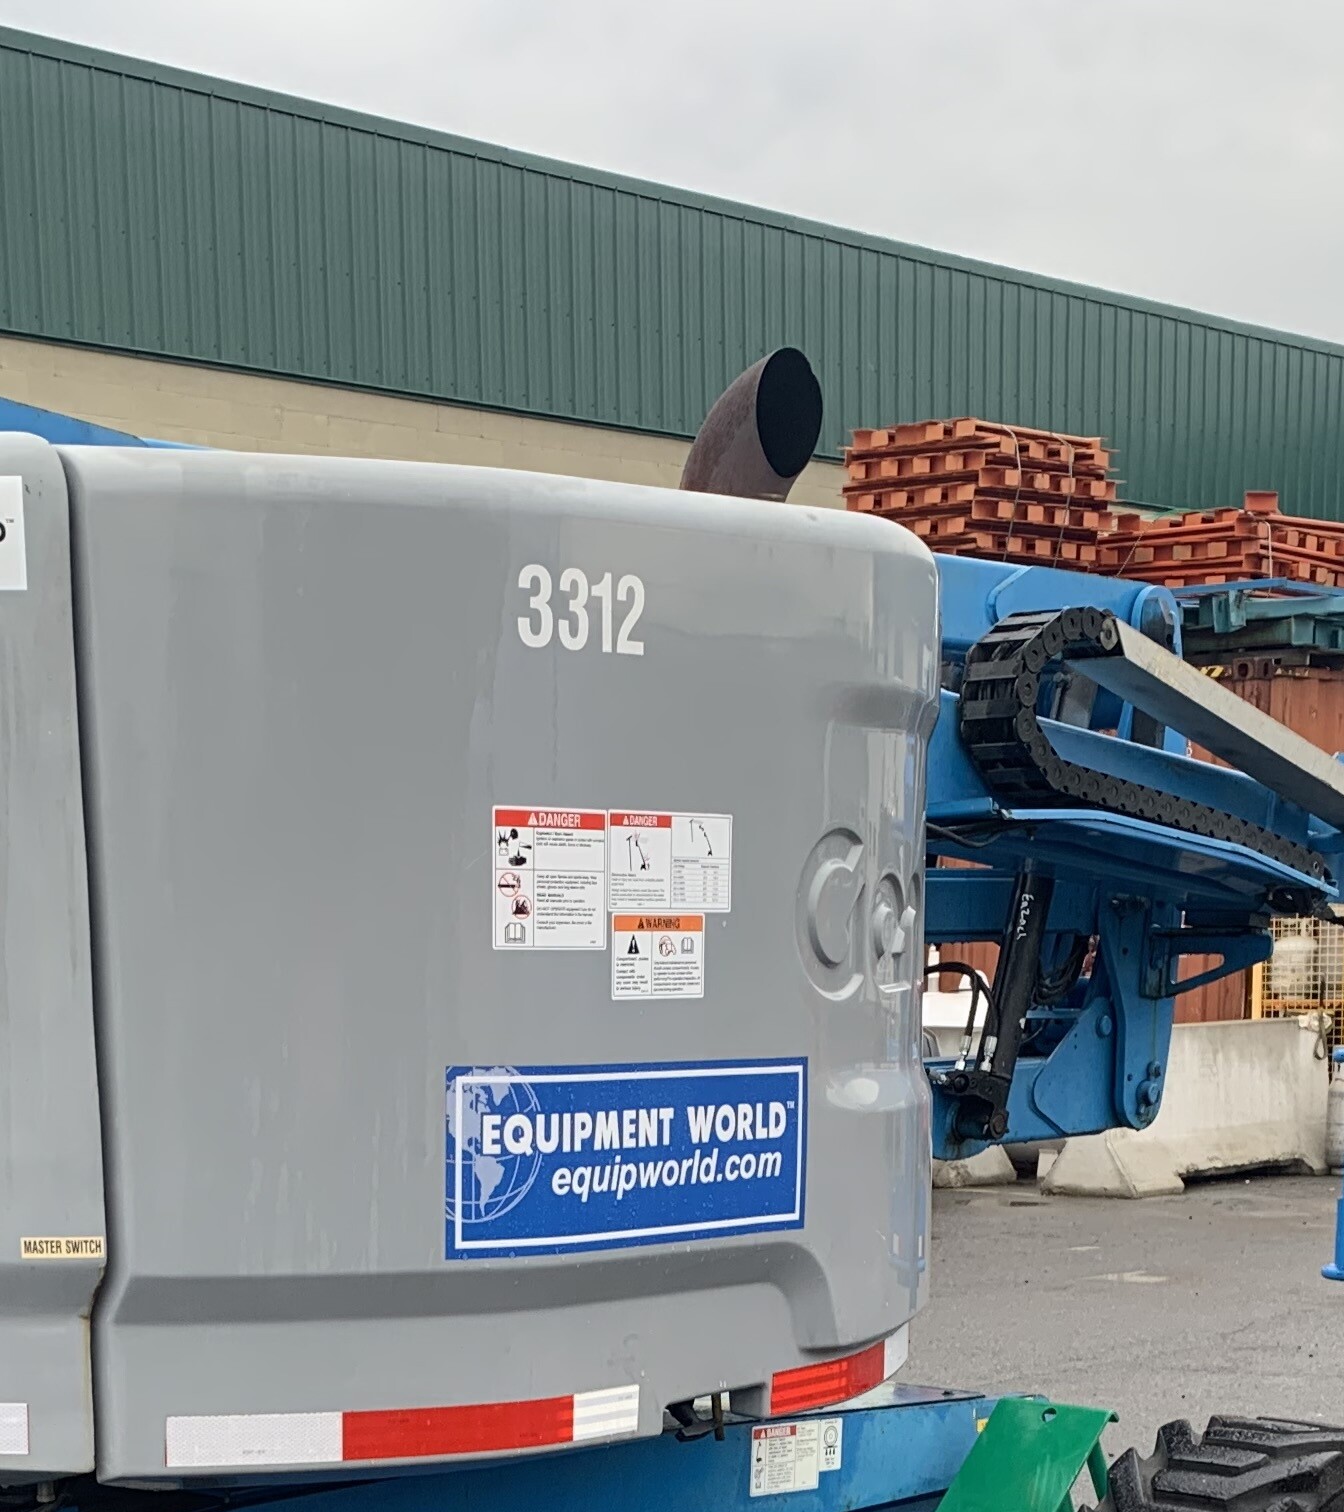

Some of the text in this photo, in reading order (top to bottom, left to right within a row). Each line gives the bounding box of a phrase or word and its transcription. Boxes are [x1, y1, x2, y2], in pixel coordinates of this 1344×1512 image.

[517, 563, 645, 656] 3312
[538, 812, 581, 828] DANGER
[629, 815, 658, 827] DANGER
[645, 917, 681, 929] WARNING
[482, 1107, 675, 1157] EQUIPMENT
[551, 1149, 783, 1203] equipworld.com
[23, 1239, 102, 1254] MASTER SWITCH
